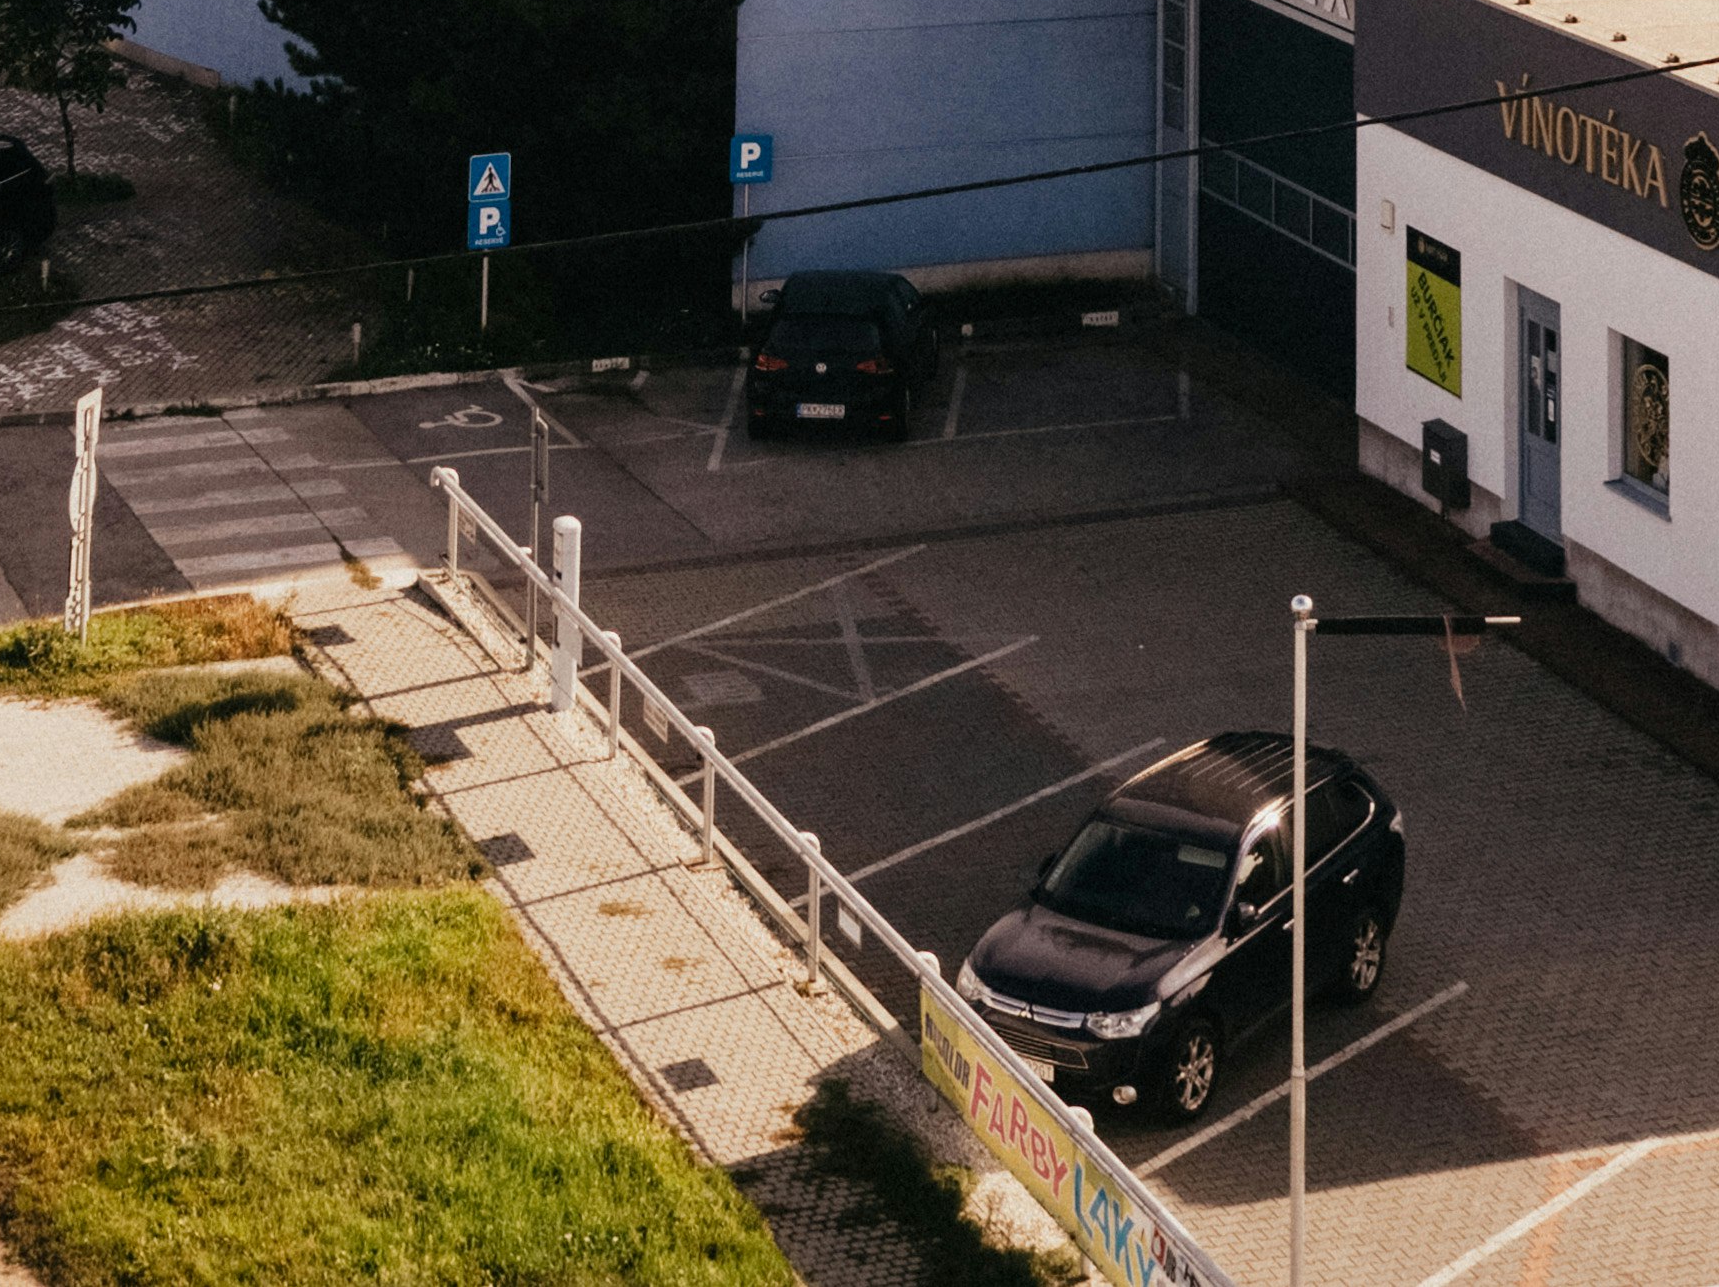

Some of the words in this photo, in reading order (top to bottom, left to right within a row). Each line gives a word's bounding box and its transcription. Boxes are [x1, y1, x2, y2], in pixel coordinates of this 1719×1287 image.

[1495, 72, 1669, 209] VÍNOTÉKA
[969, 1059, 1069, 1203] FARBY
[1073, 1161, 1156, 1287] LAKY
